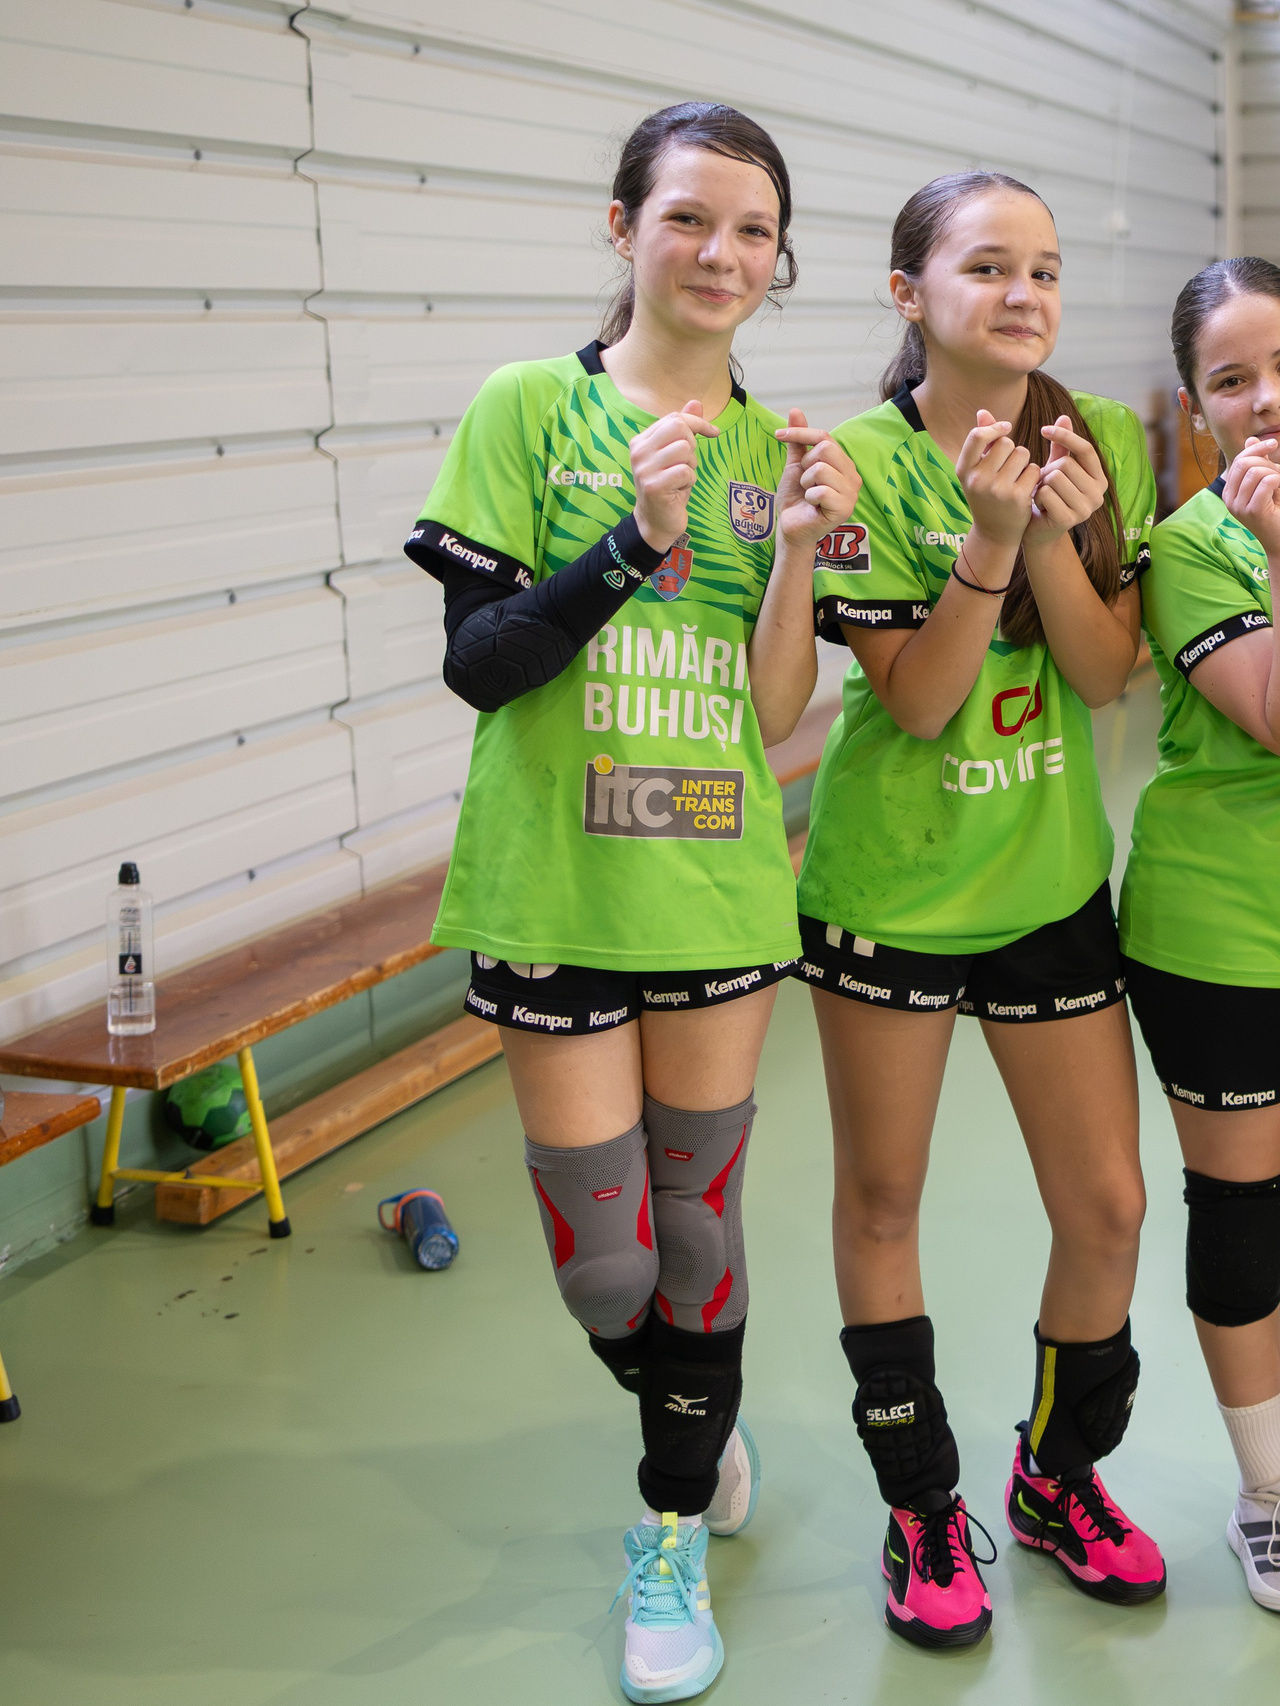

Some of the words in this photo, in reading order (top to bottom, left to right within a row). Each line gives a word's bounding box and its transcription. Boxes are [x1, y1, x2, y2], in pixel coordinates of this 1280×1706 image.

[547, 465, 623, 491] Kempa
[734, 490, 767, 510] CSO
[439, 533, 499, 572] Kempa
[913, 525, 968, 553] Kemp
[837, 601, 892, 624] Kempa
[587, 623, 751, 691] RIMĂRI
[1180, 630, 1226, 668] Kempa
[584, 682, 744, 752] BUHUȘI
[942, 736, 1066, 795] covire
[682, 780, 736, 796] INTER
[673, 797, 735, 813] TRANS
[693, 814, 735, 830] COM
[643, 989, 690, 1006] Kempa
[705, 969, 761, 998] Kempa
[838, 972, 892, 1000] Kempa
[909, 990, 950, 1009] Kempa
[466, 987, 497, 1015] Kempa
[511, 1005, 572, 1031] Kempa
[589, 1005, 628, 1027] Kempa
[987, 1002, 1037, 1018] Kempa
[1054, 990, 1106, 1012] Kempa
[1171, 1083, 1205, 1104] Kempa
[1221, 1089, 1275, 1107] Kempa
[866, 1401, 915, 1421] SELECT
